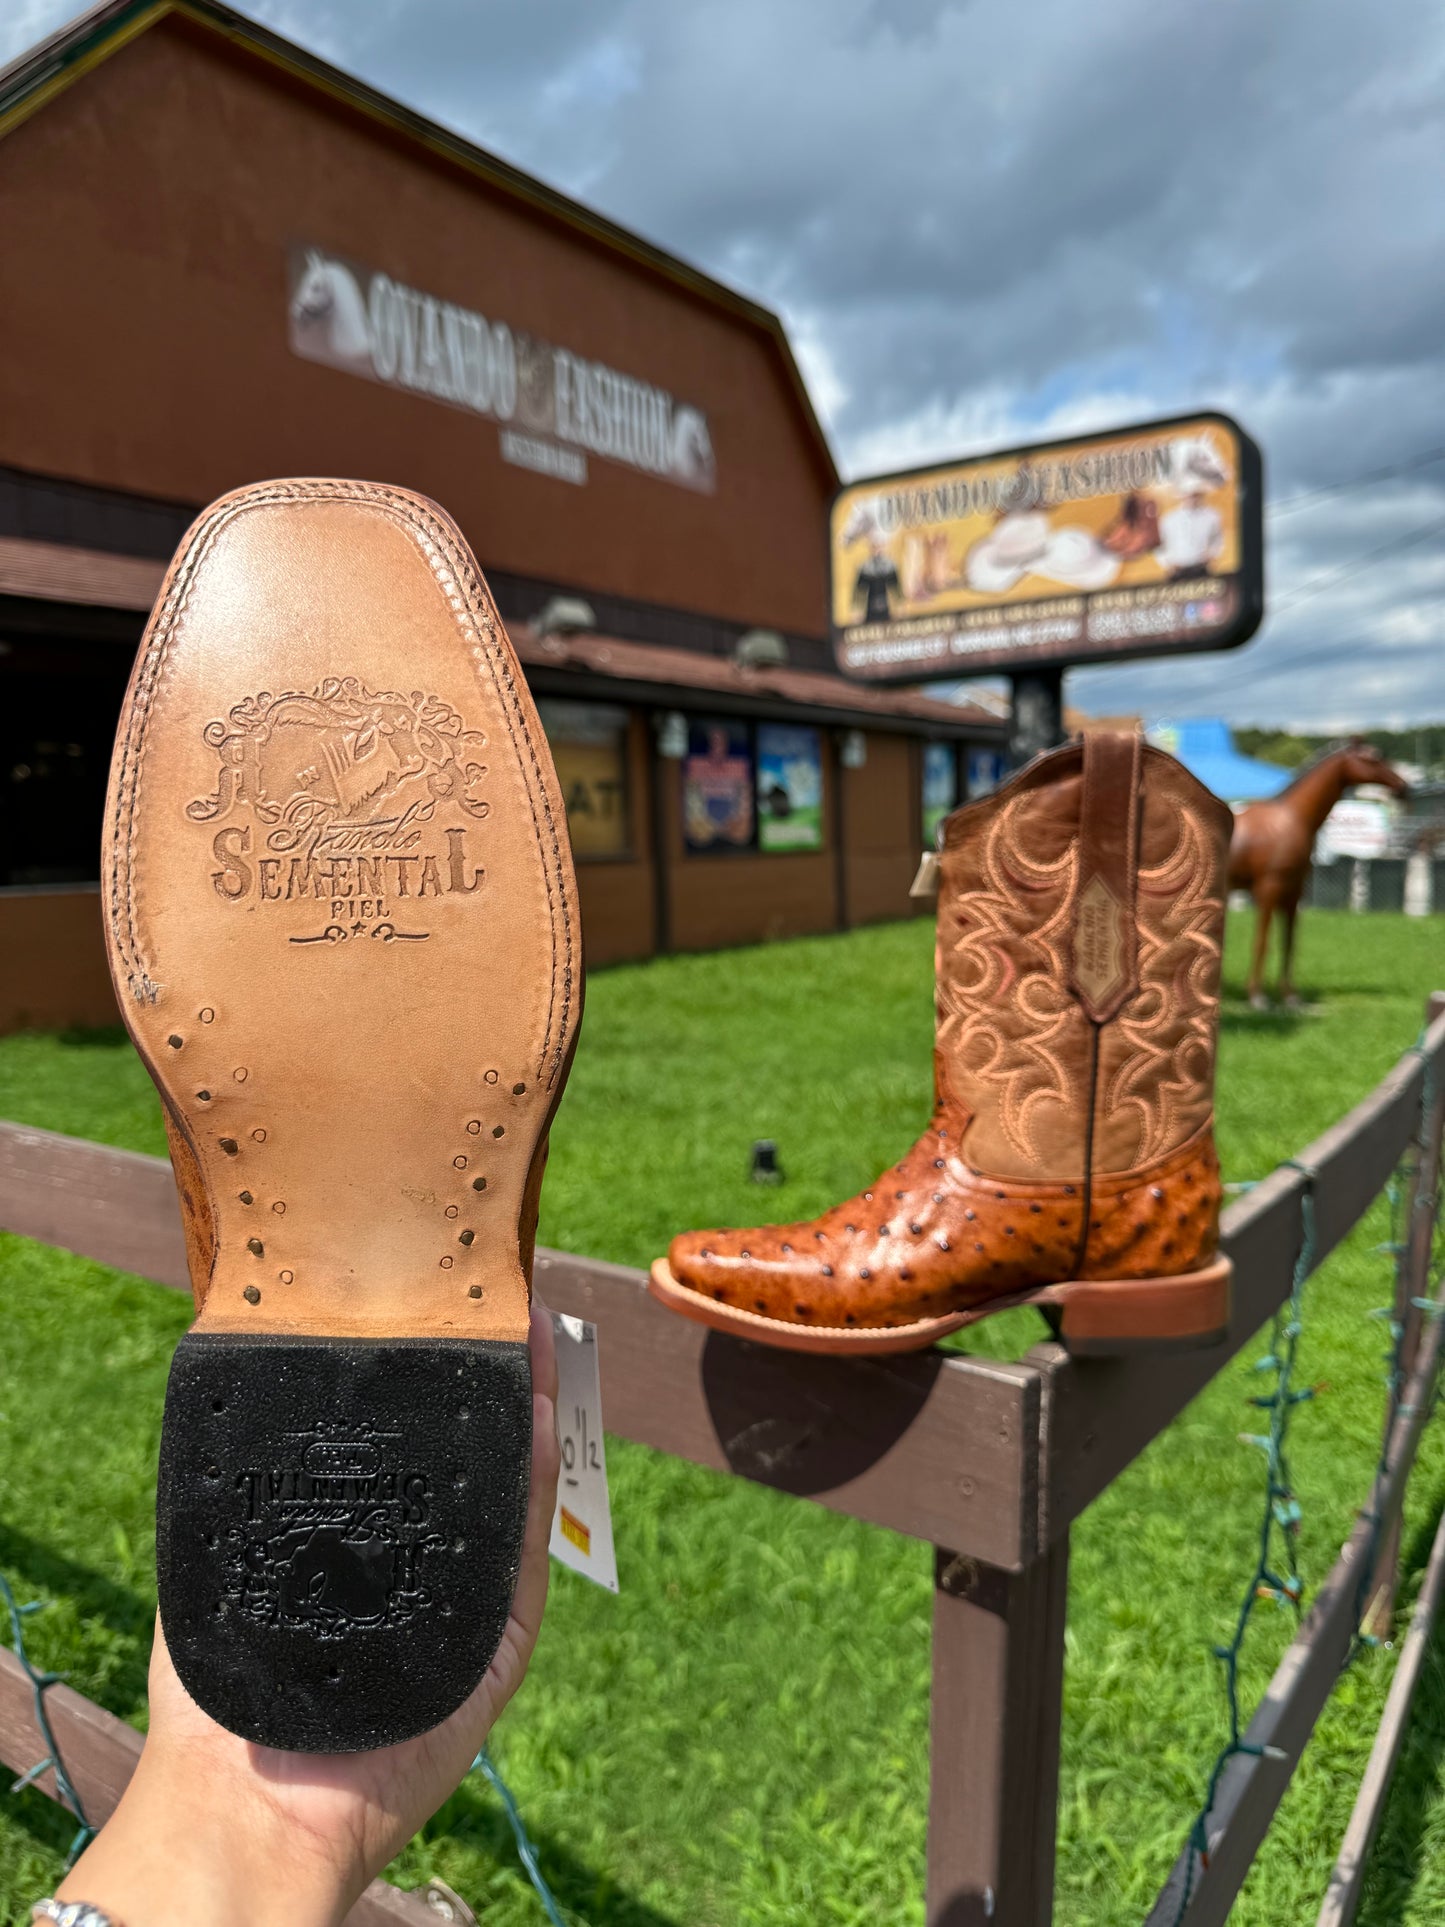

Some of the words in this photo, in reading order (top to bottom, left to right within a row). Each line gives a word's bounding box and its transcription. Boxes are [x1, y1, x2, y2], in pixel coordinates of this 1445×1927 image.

[211, 826, 484, 900] SEMENTAL
[330, 900, 391, 919] PIEL
[236, 1473, 431, 1526] SEMENTAL
